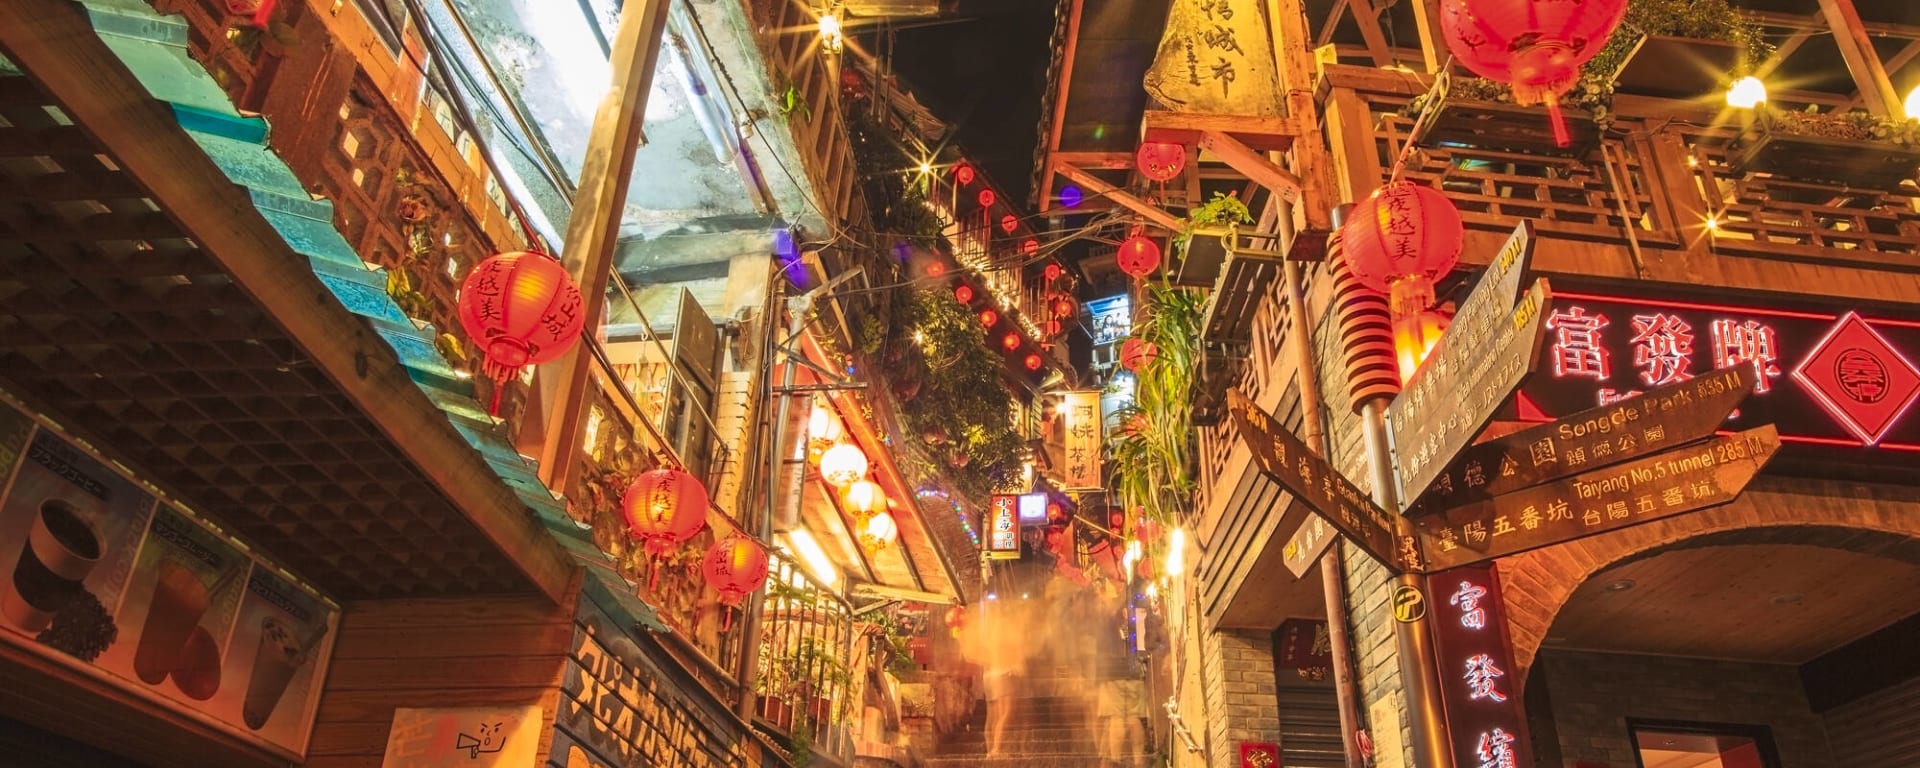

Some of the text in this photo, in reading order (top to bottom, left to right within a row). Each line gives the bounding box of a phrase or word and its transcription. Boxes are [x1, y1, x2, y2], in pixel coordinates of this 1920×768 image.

[1559, 408, 1639, 441] Songde
[1643, 388, 1693, 414] Park
[1725, 370, 1741, 389] M
[1573, 436, 1763, 501] Taiyang No.5 tunnel 285 M
[1439, 499, 1573, 552] 臺陽五番坑
[1582, 479, 1715, 526] 台陽五番坑
